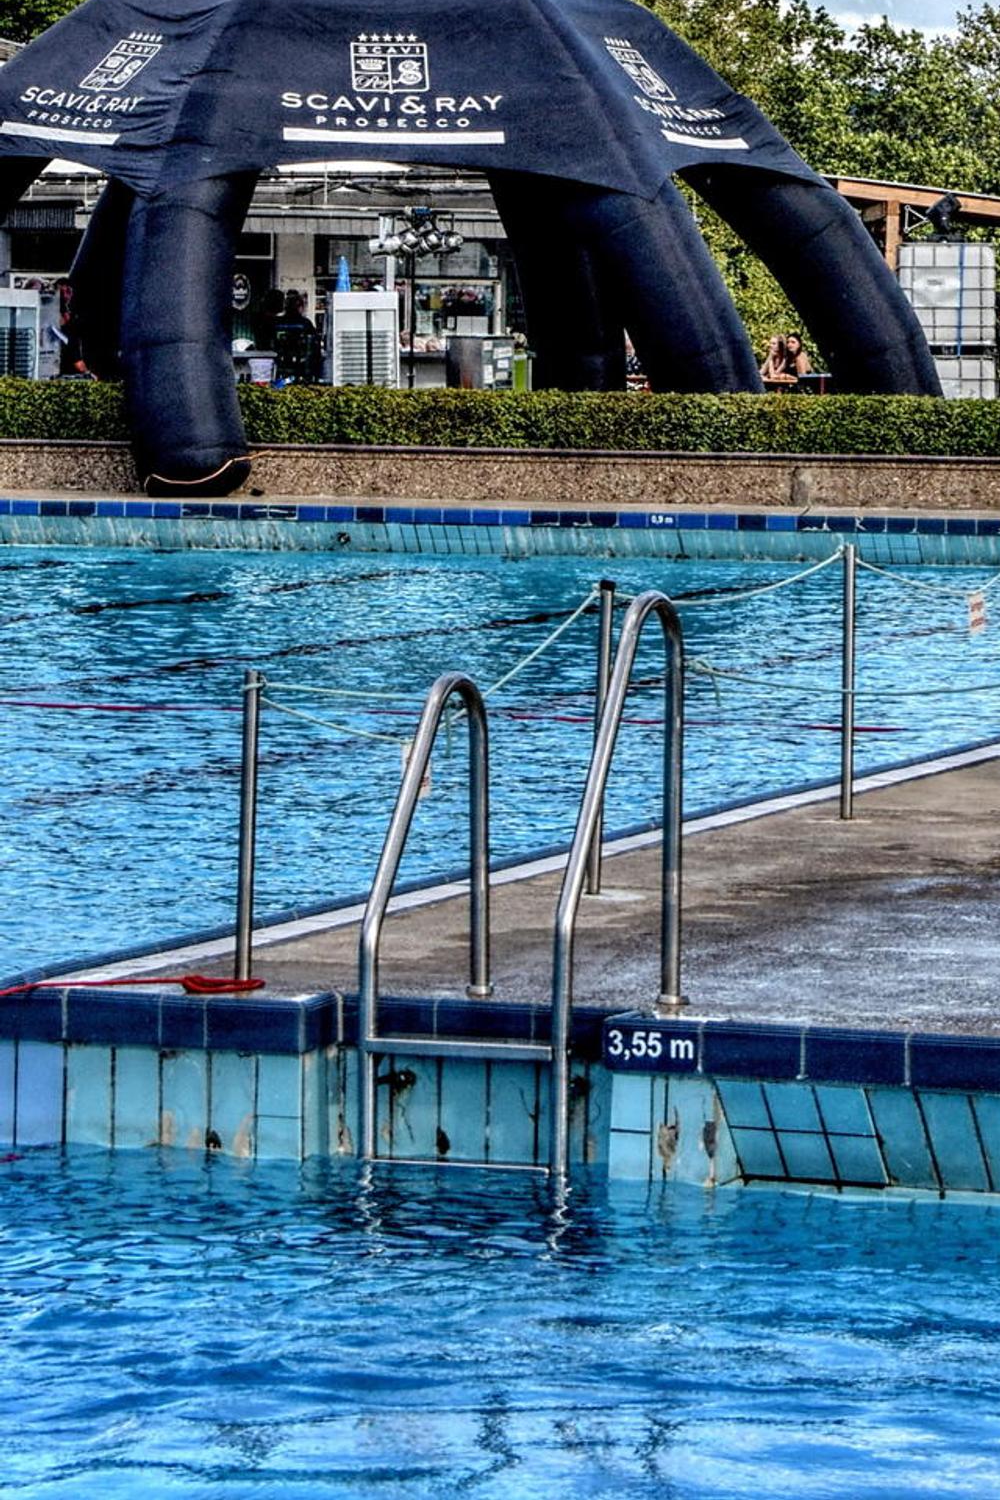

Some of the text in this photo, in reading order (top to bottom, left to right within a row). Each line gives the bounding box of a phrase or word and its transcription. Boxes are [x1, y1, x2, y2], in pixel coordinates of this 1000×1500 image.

[357, 45, 421, 54] SCAVI
[19, 85, 88, 111] SCAVI
[103, 96, 146, 113] RAY
[280, 91, 503, 115] SCAVI & RAY
[27, 109, 113, 129] PROSECCO
[315, 115, 471, 128] PROSECCO
[607, 1029, 695, 1061] 3,55 m
